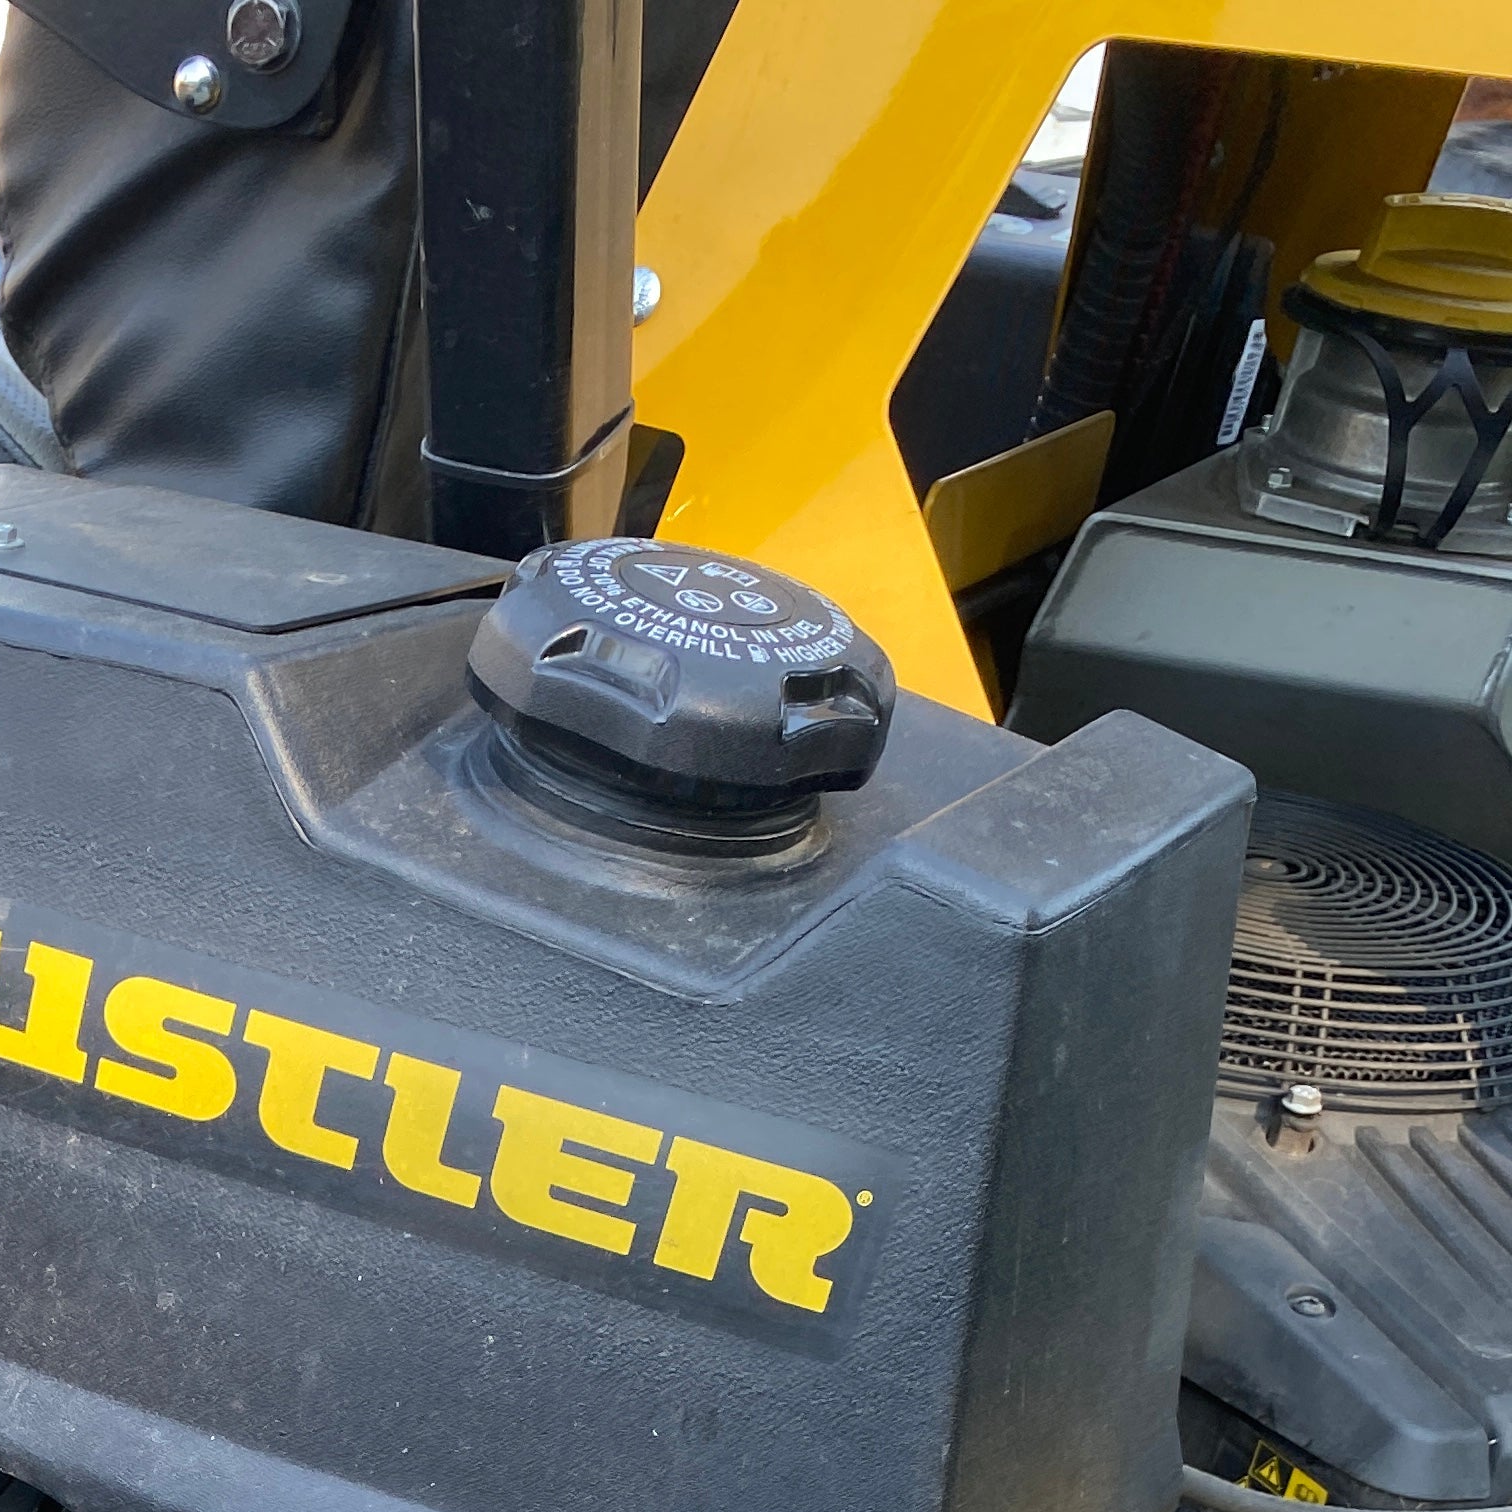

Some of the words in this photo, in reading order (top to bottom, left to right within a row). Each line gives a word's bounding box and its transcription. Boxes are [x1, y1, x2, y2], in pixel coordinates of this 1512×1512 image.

[556, 568, 585, 586] DO
[587, 557, 613, 573] OF
[590, 572, 627, 597] 10%
[569, 586, 619, 614] NOT
[621, 596, 747, 643] ETHANOL
[777, 619, 824, 643] FUEL
[614, 612, 742, 660] OVERFILL
[750, 629, 780, 644] IN
[773, 635, 848, 664] HIGHER
